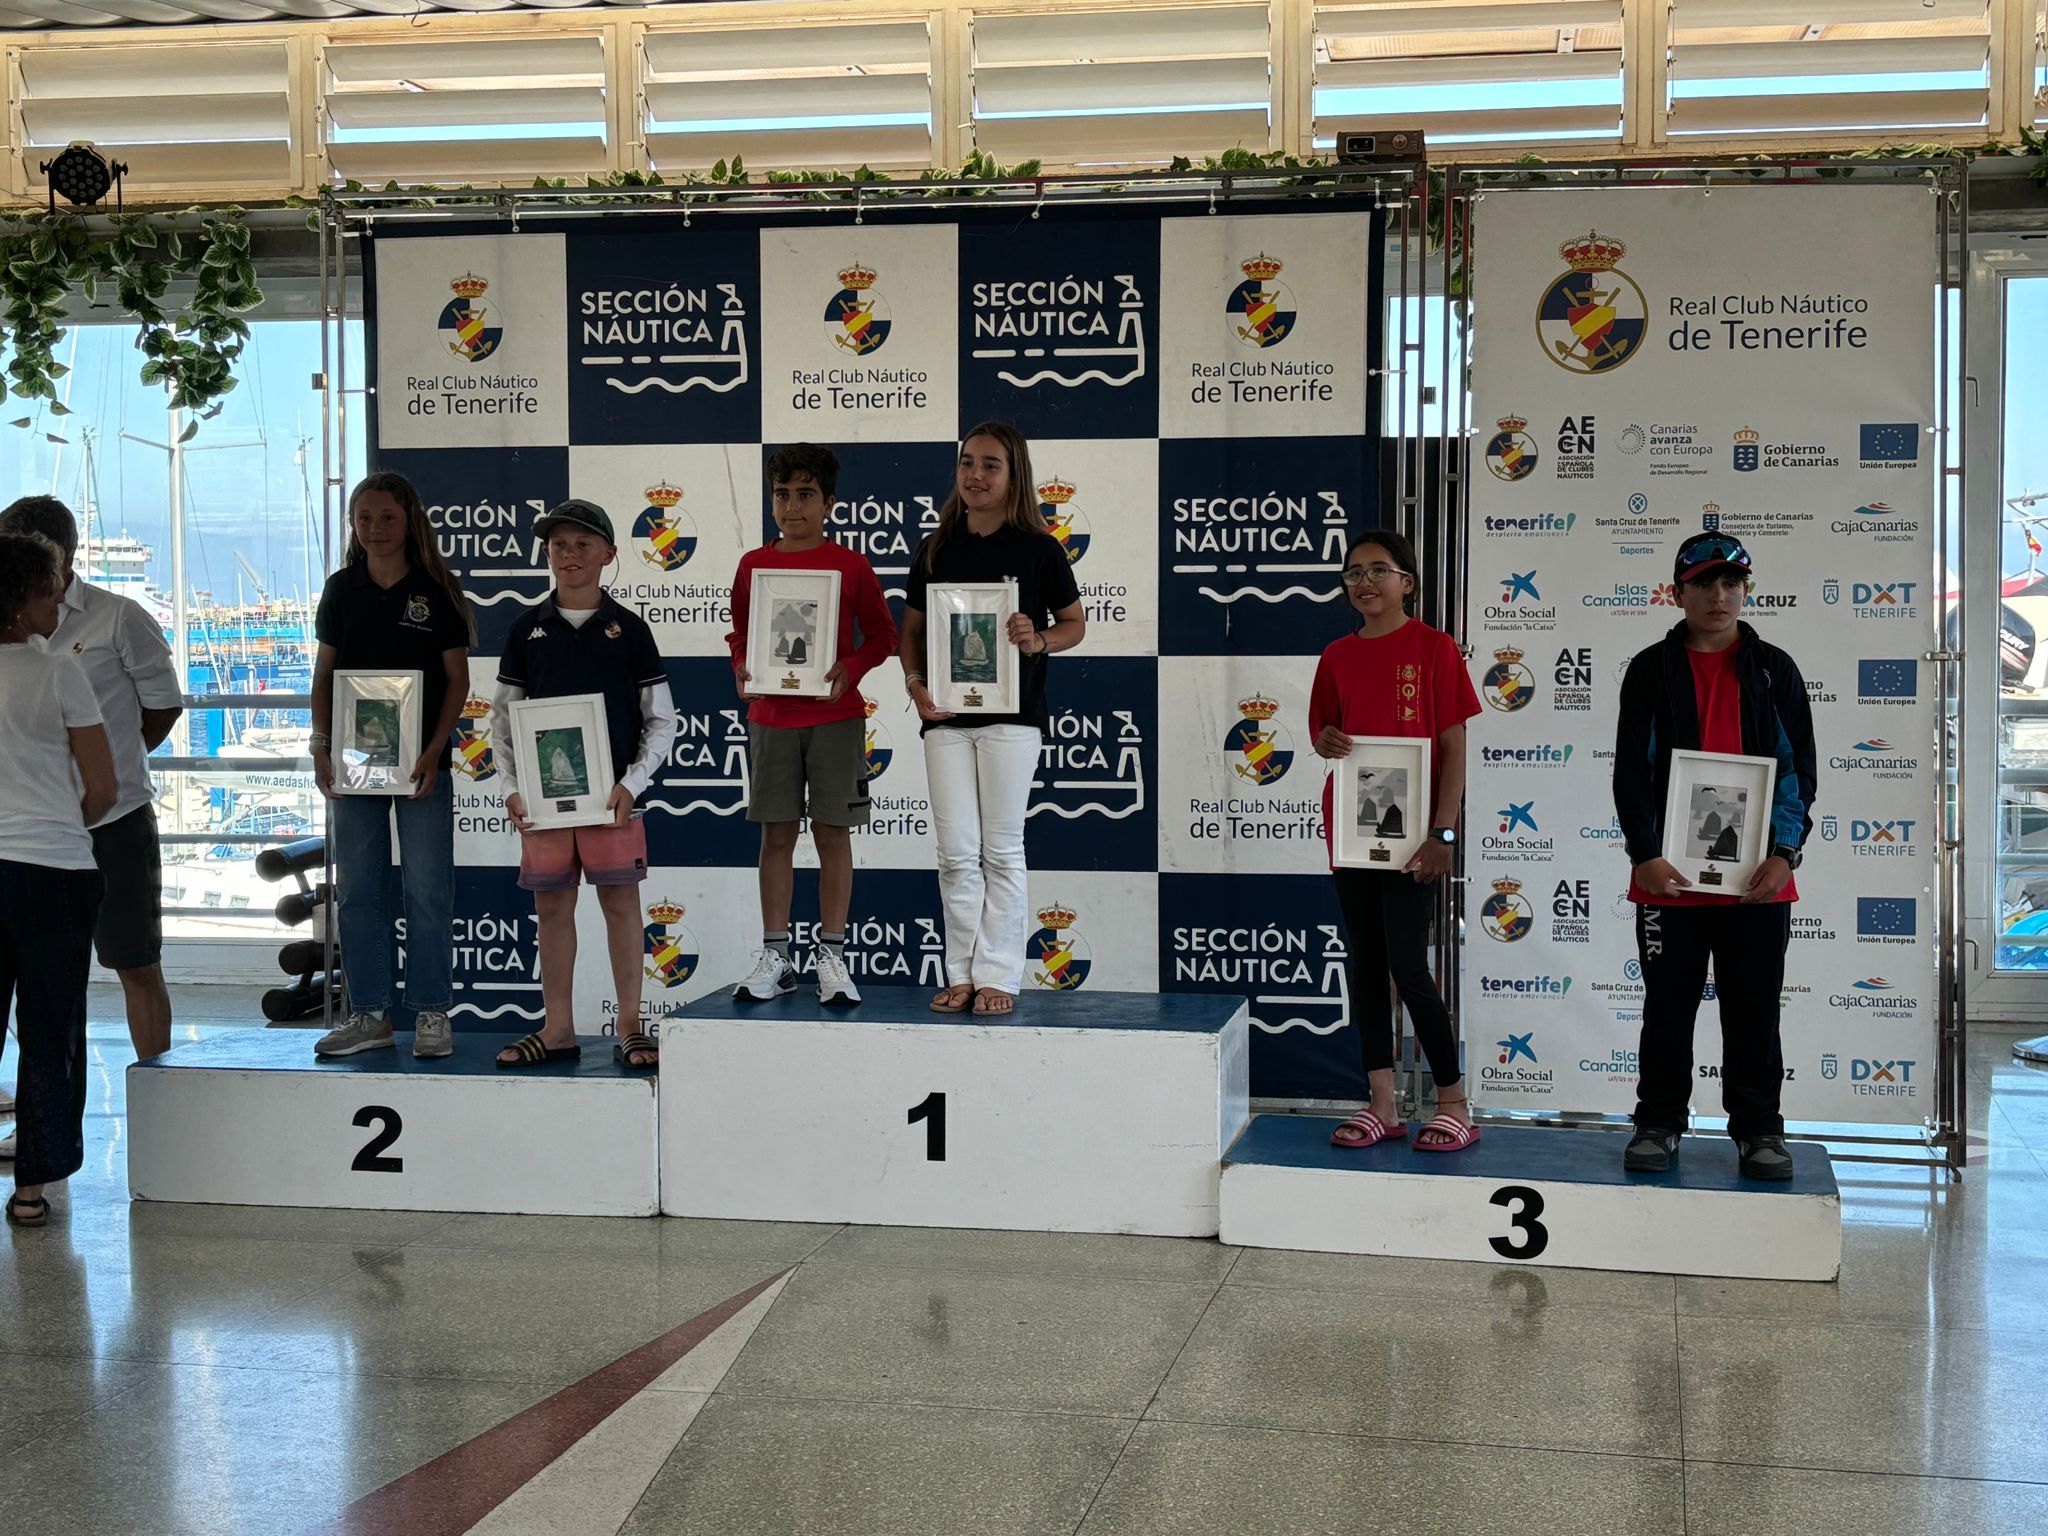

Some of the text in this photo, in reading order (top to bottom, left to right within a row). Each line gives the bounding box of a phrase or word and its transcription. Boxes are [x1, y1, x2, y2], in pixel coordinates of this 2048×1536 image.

[581, 283, 706, 314] SECCIÓN
[973, 275, 1103, 307] SECCIÓN
[1670, 294, 1867, 316] Real Club Náutico
[584, 314, 713, 344] NÁUTICA
[975, 305, 1110, 337] NÁUTICA
[1669, 319, 1867, 350] de Tenerife
[793, 368, 927, 384] Real Club Náutico
[1192, 360, 1333, 377] Real Club Náutico
[408, 374, 537, 390] Real Club Náutico
[793, 387, 927, 409] de Tenerife
[1192, 379, 1332, 402] de Tenerife
[408, 392, 537, 415] de Tenerife
[1559, 416, 1594, 434] AE
[1650, 424, 1697, 434] Canarias
[1674, 445, 1712, 456] Europa
[1764, 444, 1825, 454] Gobierno
[1764, 456, 1839, 467] de Canarias
[426, 498, 516, 528] CCIÓN
[825, 495, 903, 525] CIÓN
[1174, 491, 1307, 523] SECCIÓN
[1596, 518, 1618, 526] Santa
[1619, 518, 1636, 526] Cruz
[1722, 513, 1762, 521] Gobierno
[1764, 513, 1774, 521] de
[1831, 519, 1917, 535] CajaCanarias
[437, 534, 523, 557] UTICA
[1176, 522, 1313, 553] NÁUTICA
[1621, 547, 1654, 555] Deportes
[636, 584, 732, 598] Club Náutico
[1080, 583, 1126, 596] áutico
[1615, 584, 1647, 595] Islas
[1853, 583, 1916, 604] DXT
[1583, 595, 1647, 606] Canarias
[1744, 595, 1797, 607] ACRUZ
[635, 602, 731, 622] Tenerife
[1085, 600, 1126, 622] rife
[1485, 607, 1555, 618] Obra Social
[1853, 608, 1916, 618] TENERIFE
[1555, 648, 1591, 666] AE
[1884, 698, 1916, 706] Europea
[1042, 745, 1109, 768] TICA
[1830, 756, 1917, 772] CajaCanarias
[245, 774, 316, 790] www.aedasho
[1191, 799, 1321, 813] Real Club Náutic
[1190, 817, 1326, 839] de Tenerife
[1851, 820, 1916, 842] DXT
[1482, 837, 1553, 849] Obra Social
[1851, 845, 1916, 856] TENERIFE
[1482, 853, 1519, 861] Fundación
[1553, 880, 1589, 898] AE
[1174, 922, 1307, 953] SECCIÓN
[1883, 937, 1915, 945] Europea
[1176, 952, 1313, 984] NÁUTICA
[1592, 983, 1613, 991] Santa
[1615, 983, 1632, 991] Cruz
[1783, 985, 1811, 993] narias
[639, 1001, 671, 1014] Club
[1829, 995, 1917, 1010] CajaCanarias
[1617, 1012, 1642, 1021] Deport
[1612, 1049, 1637, 1061] Isla
[1482, 1067, 1552, 1081] Obra Social
[1580, 1060, 1638, 1073] Canaria
[1852, 1059, 1915, 1082] DXT
[1482, 1084, 1519, 1092] Fundación
[1851, 1084, 1916, 1096] TENERIFE
[908, 1092, 946, 1161] 1
[351, 1105, 403, 1173] 2
[1488, 1186, 1548, 1259] 3
